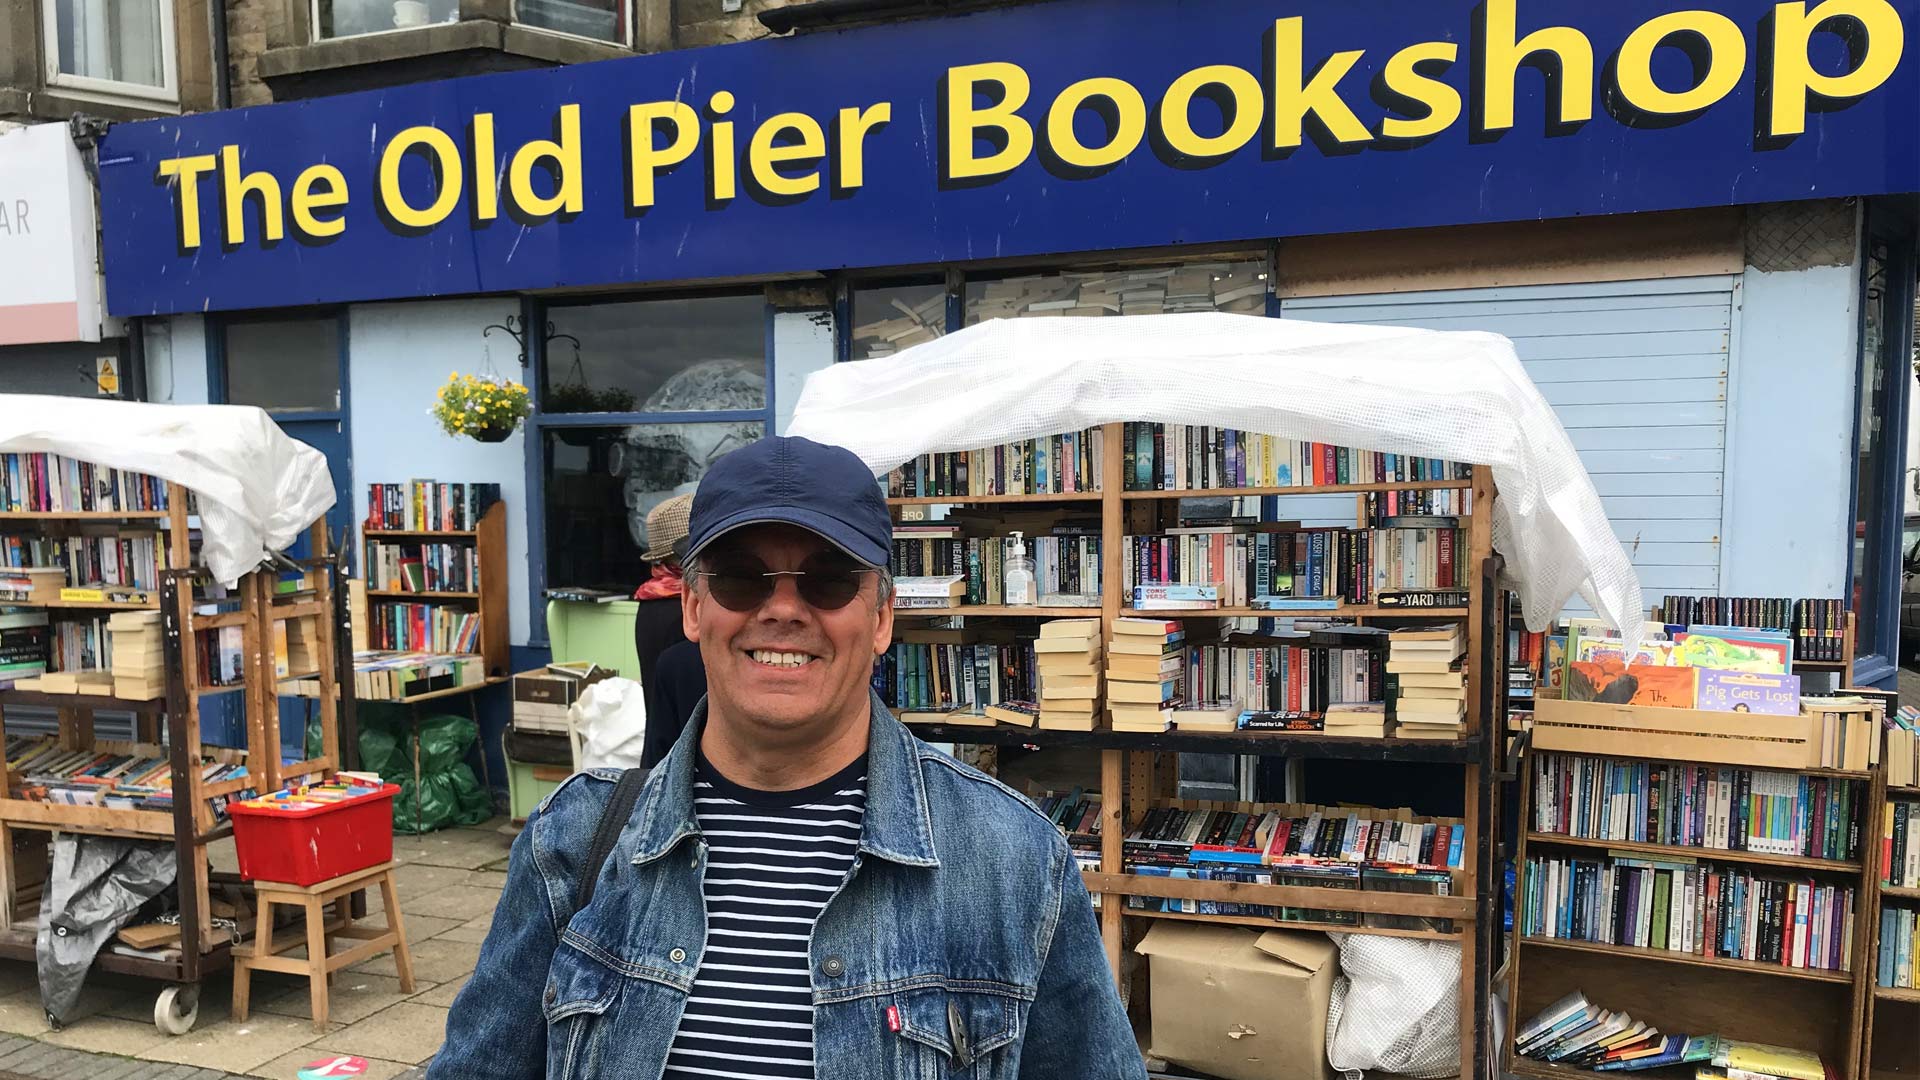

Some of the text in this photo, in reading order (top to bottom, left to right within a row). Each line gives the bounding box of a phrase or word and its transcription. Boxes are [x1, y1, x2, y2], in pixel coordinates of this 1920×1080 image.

[158, 0, 1905, 248] The Old Pier Bookshop
[1405, 593, 1434, 607] YARD
[1649, 689, 1668, 703] The
[1706, 684, 1793, 703] Pig Gets Lost
